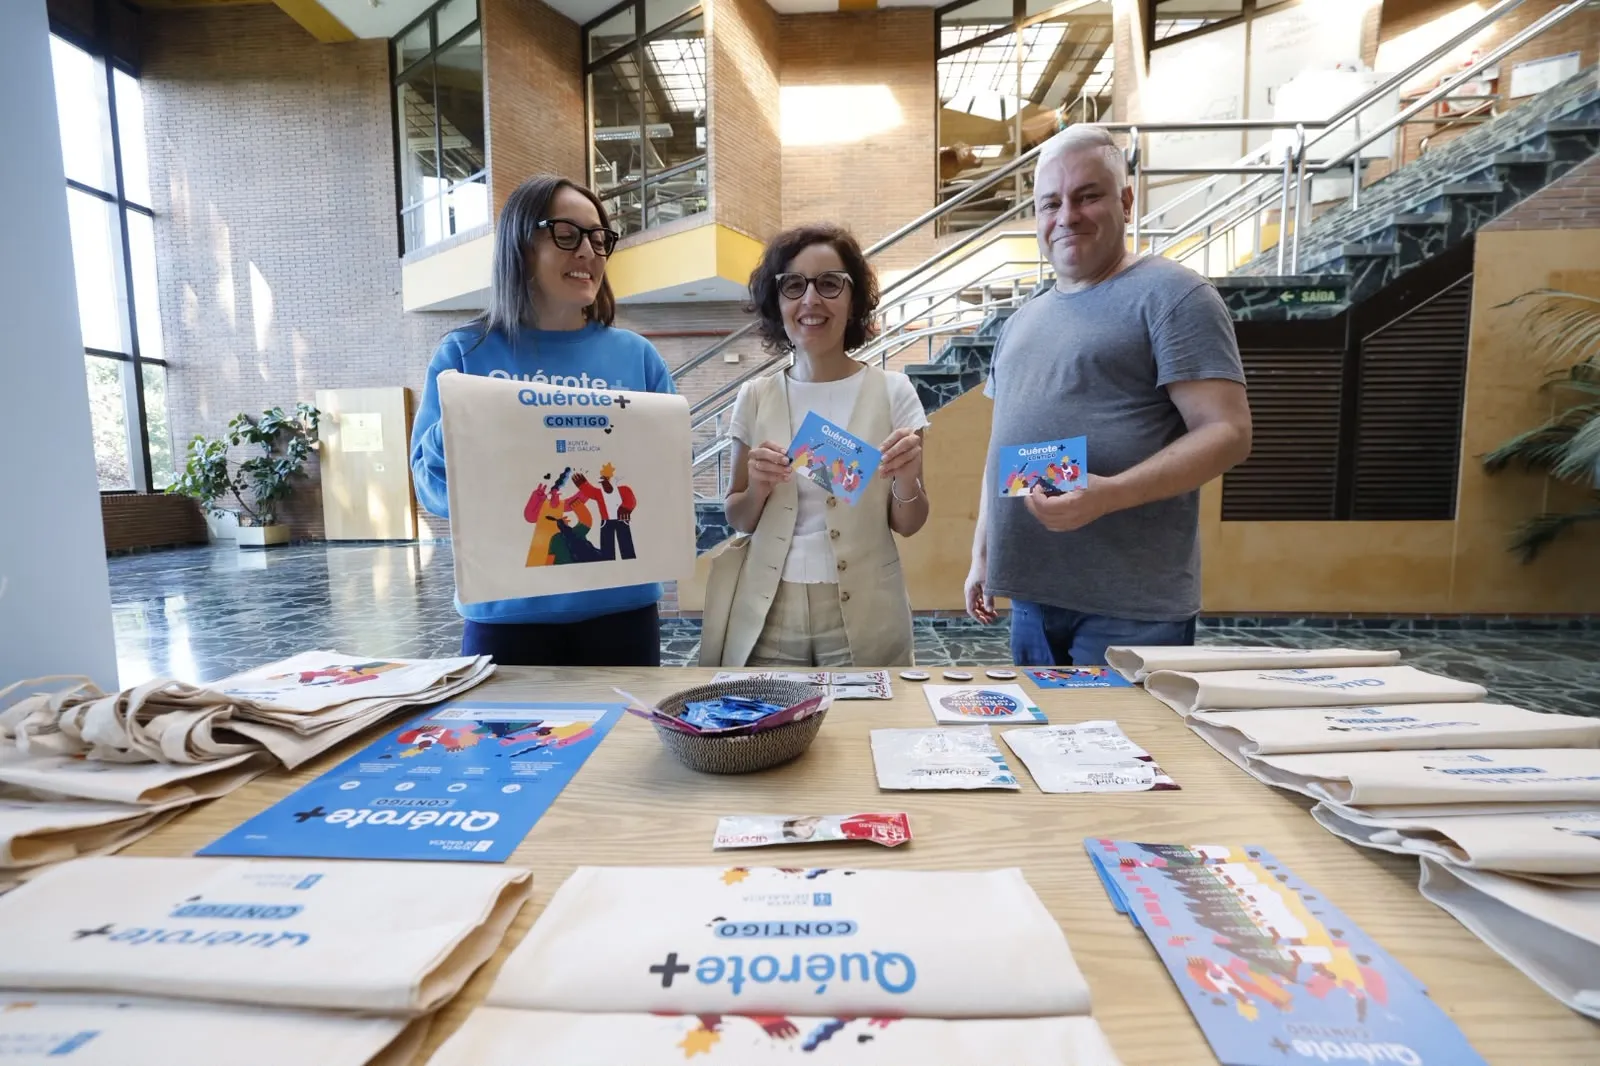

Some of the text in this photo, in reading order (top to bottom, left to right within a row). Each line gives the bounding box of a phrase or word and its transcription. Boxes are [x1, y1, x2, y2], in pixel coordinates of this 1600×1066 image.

[546, 416, 607, 427] CONTIGO
[376, 799, 450, 807] CONTIGO
[720, 921, 852, 937] CONTIGO
